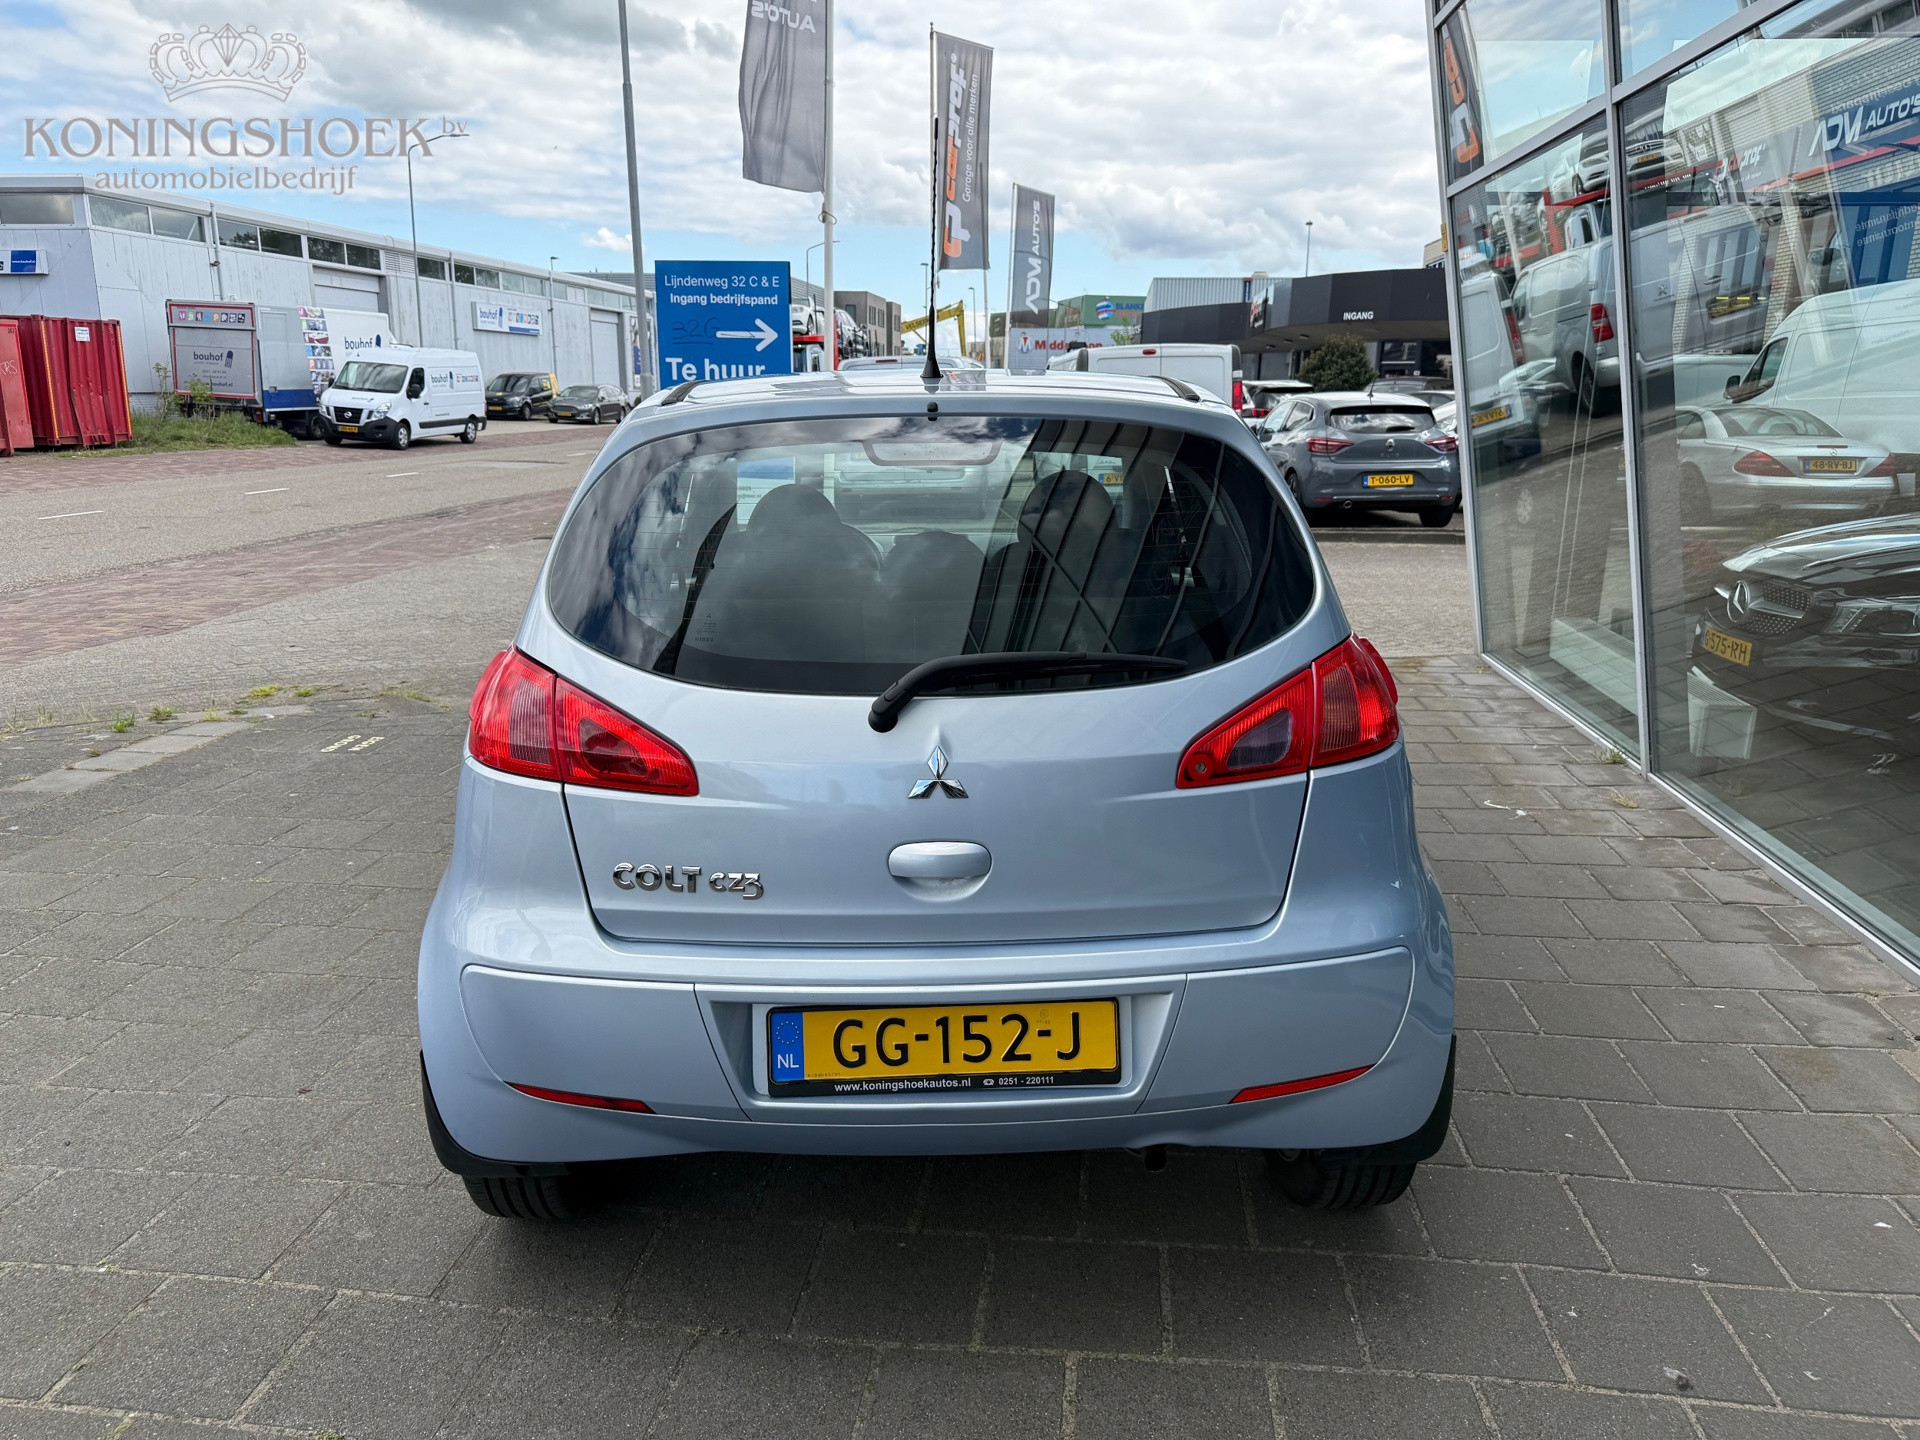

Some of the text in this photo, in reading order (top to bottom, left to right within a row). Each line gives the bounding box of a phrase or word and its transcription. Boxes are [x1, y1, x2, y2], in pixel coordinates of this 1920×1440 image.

[962, 74, 978, 202] Garage voor alle merken
[1033, 200, 1041, 256] AUTO'S
[664, 275, 780, 289] Lijndenweg 32 C & E
[670, 293, 778, 307] Ingang bedrijfspand
[1343, 311, 1374, 321] INGANG
[193, 352, 224, 361] bouhof
[665, 357, 698, 380] Te
[704, 358, 766, 381] huur
[1370, 475, 1410, 484] T-060-LV
[612, 862, 702, 893] COLT
[833, 1011, 1081, 1068] GG-152-J
[777, 1053, 799, 1069] NL
[835, 1076, 971, 1092] www.koningshoekautos.nl
[998, 1078, 1018, 1086] 0251
[1026, 1076, 1054, 1085] 220111
